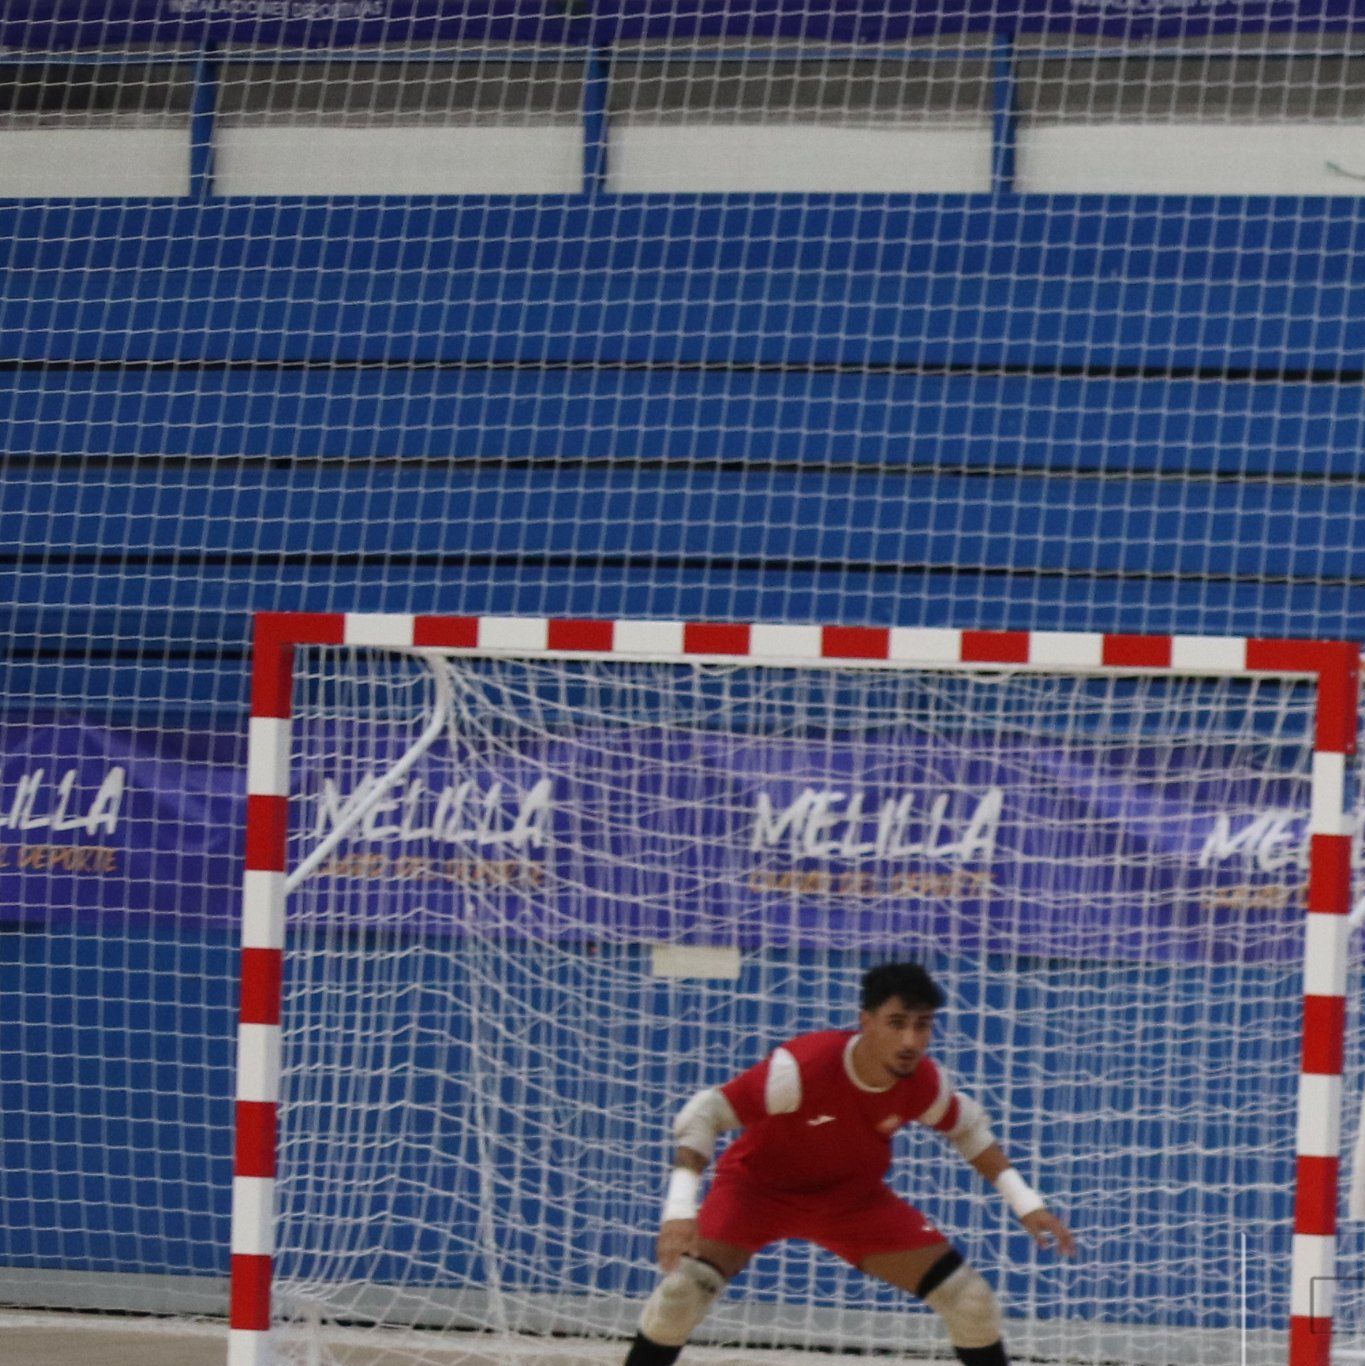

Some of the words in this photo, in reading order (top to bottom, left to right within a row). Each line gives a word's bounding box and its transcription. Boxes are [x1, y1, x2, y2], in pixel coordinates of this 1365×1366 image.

[0, 766, 125, 835] ILLA
[316, 775, 551, 849] MELILLA
[752, 787, 1003, 861] MELILLA
[17, 845, 117, 873] DEPORTE
